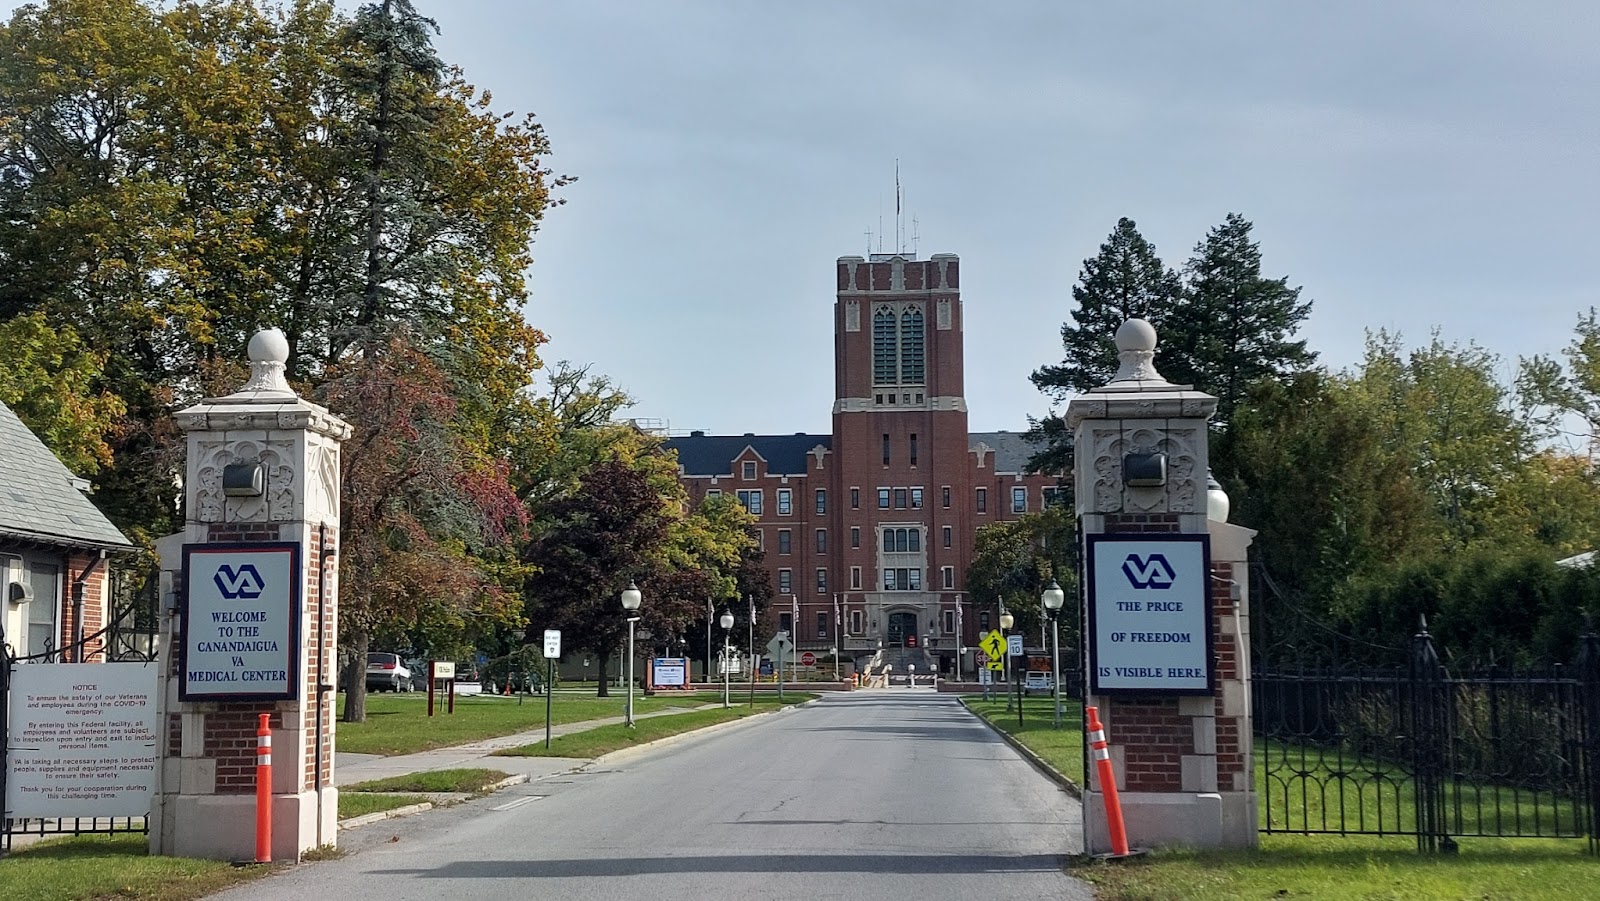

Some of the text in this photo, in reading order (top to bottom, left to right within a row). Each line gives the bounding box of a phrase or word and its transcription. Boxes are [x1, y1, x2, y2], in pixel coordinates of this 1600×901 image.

[1121, 553, 1177, 590] VA
[213, 564, 266, 600] VA
[1116, 601, 1184, 612] THE PRICE
[211, 611, 267, 623] WELCOME
[217, 626, 260, 638] TO THE
[1111, 632, 1191, 643] OF FREEDOM
[197, 641, 278, 652] CANANDAIGUA
[1011, 646, 1021, 654] 10
[231, 656, 245, 667] VA
[188, 670, 287, 682] MEDICAL CENTER
[1099, 667, 1206, 678] IS VISIBLE HERE.
